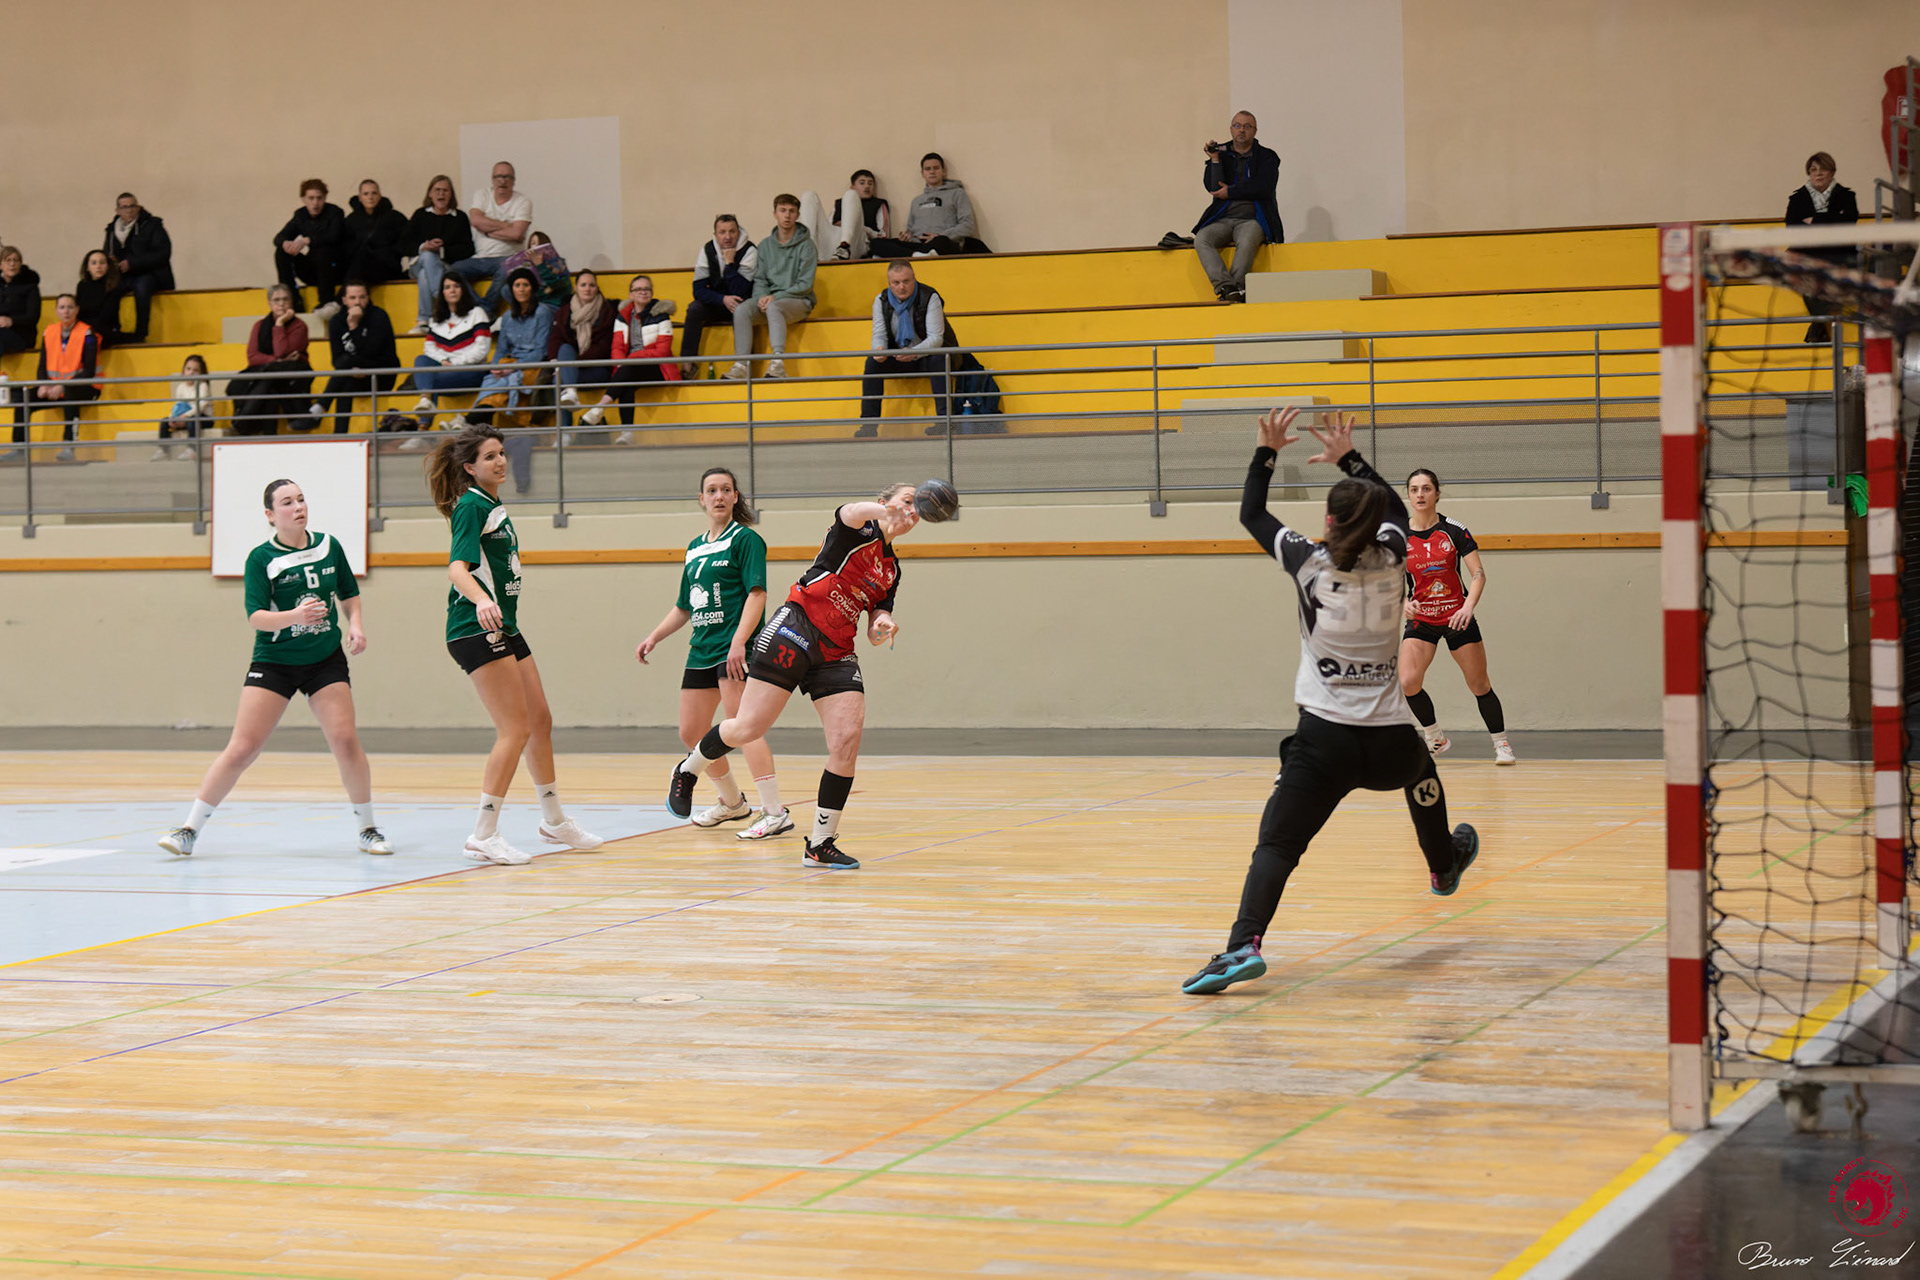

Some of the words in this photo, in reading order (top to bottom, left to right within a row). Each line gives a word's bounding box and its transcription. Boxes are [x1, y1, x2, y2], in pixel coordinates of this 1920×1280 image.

[303, 565, 320, 590] 6
[694, 556, 709, 580] 7
[773, 644, 796, 669] 33
